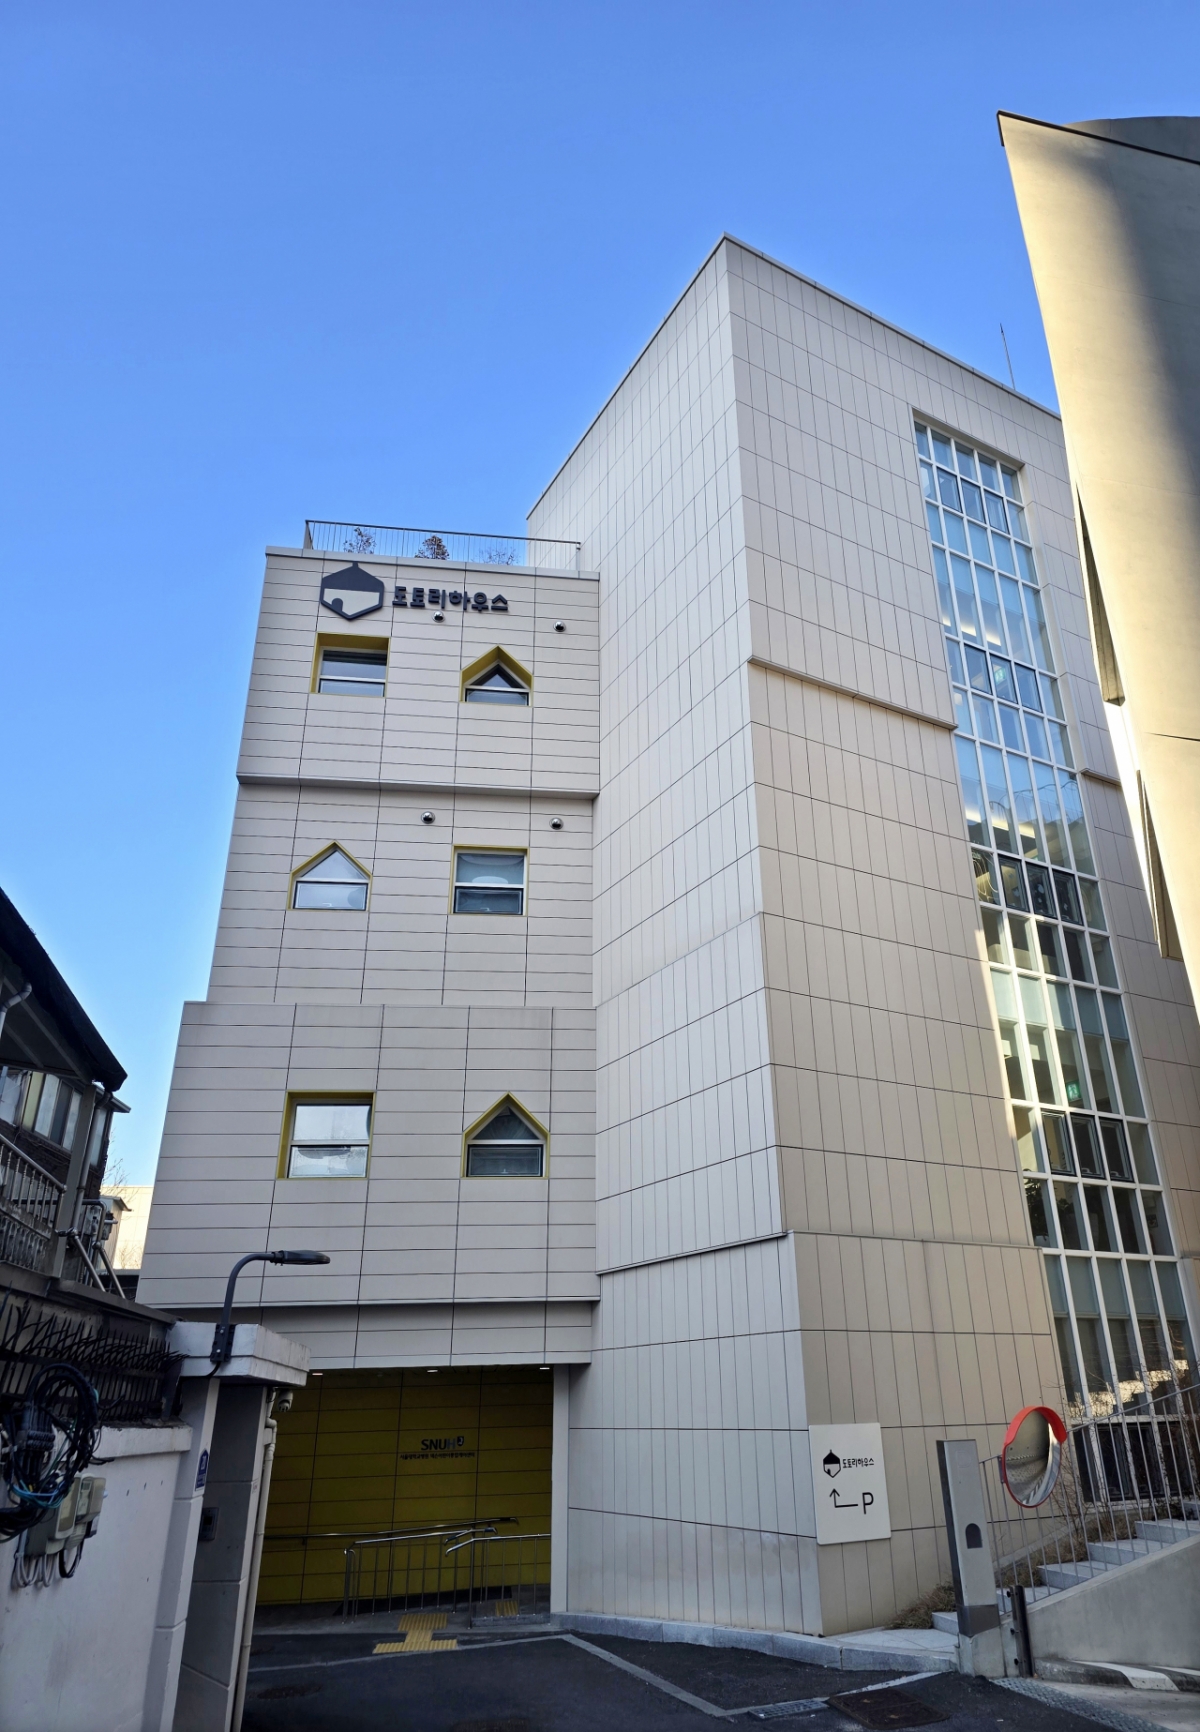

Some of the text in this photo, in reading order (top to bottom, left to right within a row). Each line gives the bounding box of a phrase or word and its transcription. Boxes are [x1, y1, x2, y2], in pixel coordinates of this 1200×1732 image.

[392, 586, 509, 612] 도토리하우스
[421, 1438, 456, 1451] SNUH
[842, 1457, 875, 1469] 도토리하우스
[862, 1492, 874, 1515] P
